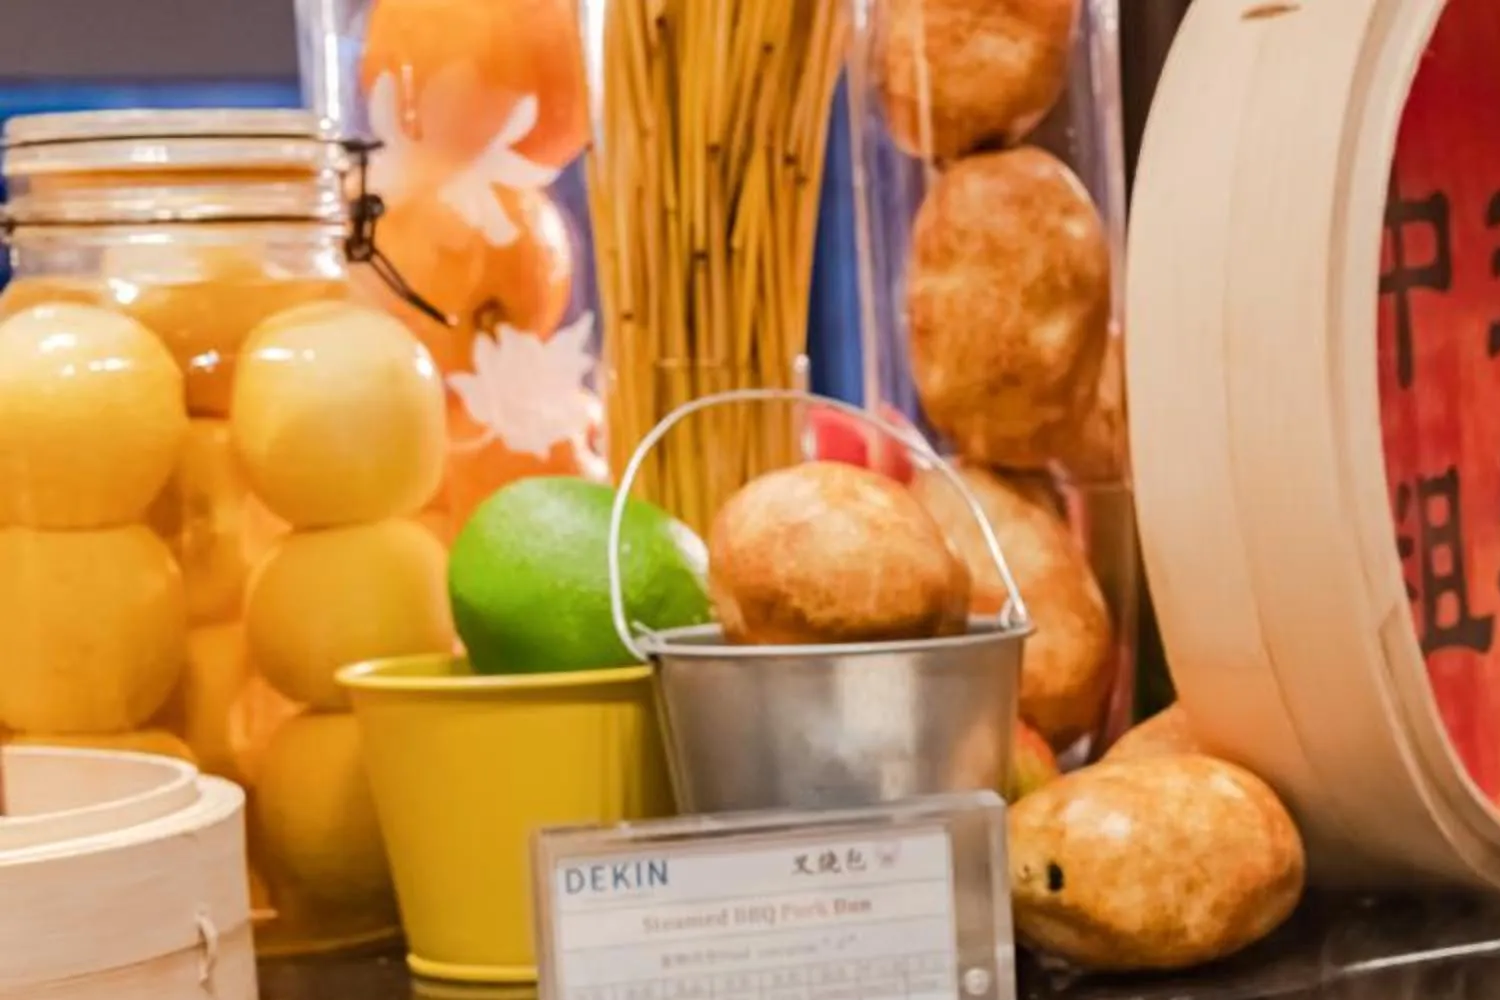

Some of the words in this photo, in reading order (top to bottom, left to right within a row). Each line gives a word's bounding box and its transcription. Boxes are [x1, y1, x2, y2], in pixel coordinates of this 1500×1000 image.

[791, 847, 867, 876] 叉烧包
[565, 860, 669, 895] DEKIN
[642, 908, 728, 933] Steamed
